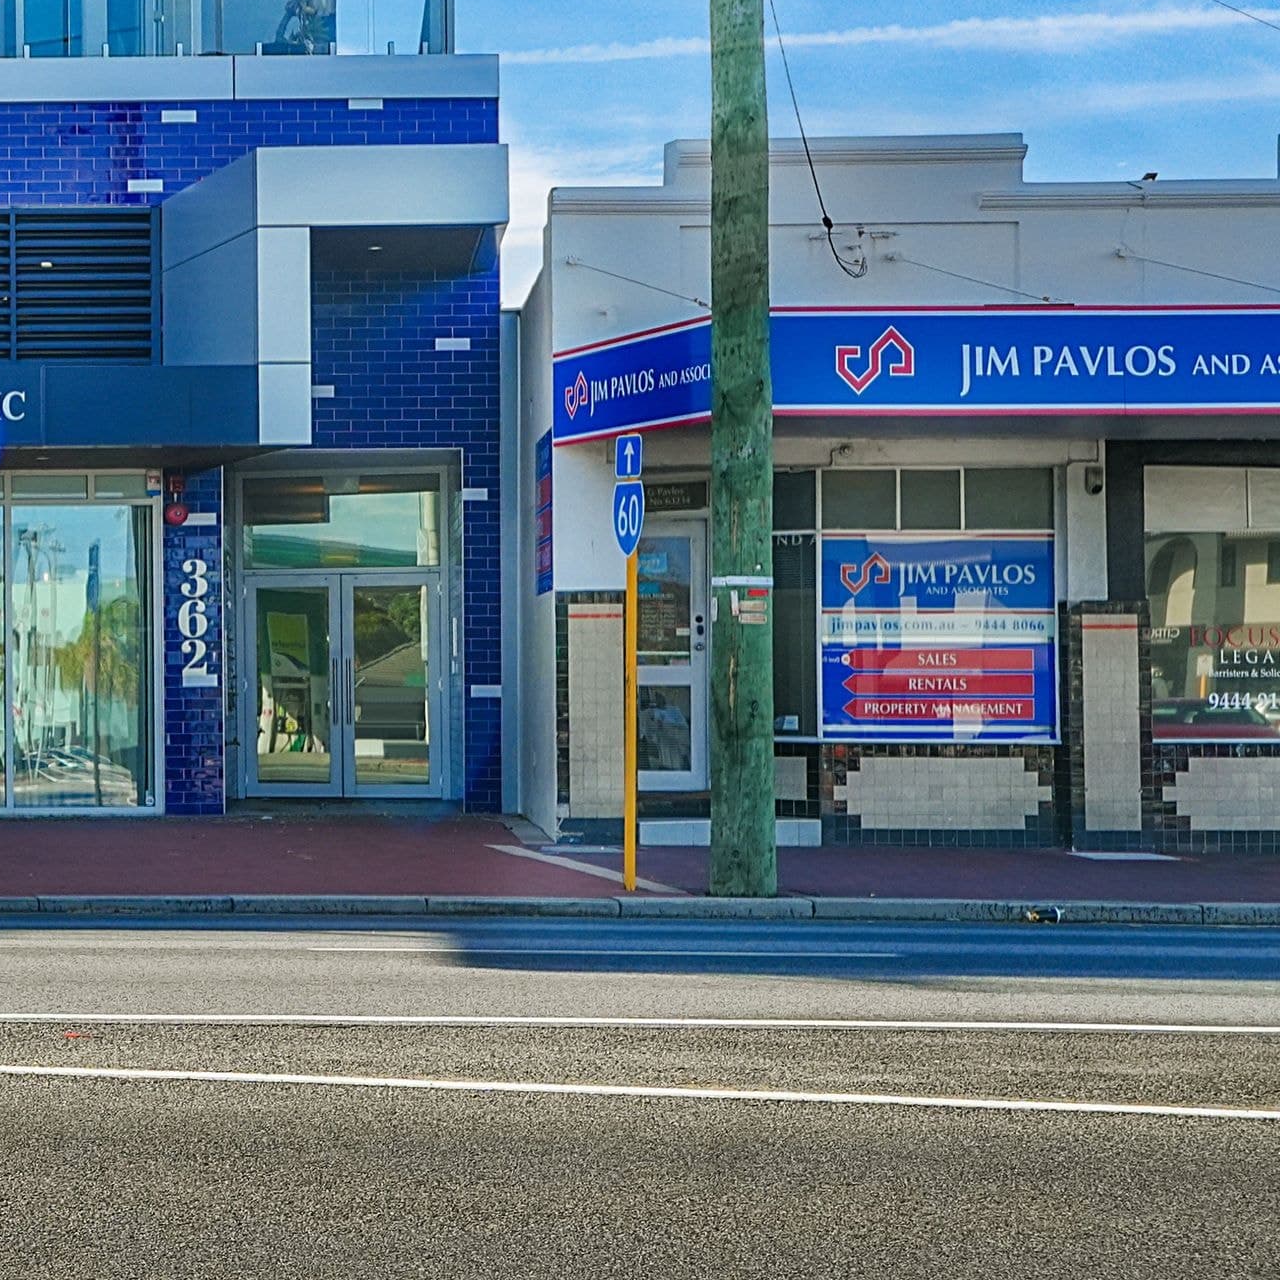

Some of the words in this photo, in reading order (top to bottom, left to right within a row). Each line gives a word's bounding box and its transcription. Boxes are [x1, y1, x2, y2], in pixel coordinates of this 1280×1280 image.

[960, 344, 1020, 396] JIM
[1034, 345, 1177, 377] PAVLOS
[1192, 354, 1251, 376] AND
[1260, 354, 1280, 376] A
[591, 380, 608, 417] JIM
[611, 369, 655, 399] PAVLOS
[658, 371, 678, 389] AND
[618, 494, 639, 537] 60
[898, 563, 936, 596] JIM
[944, 564, 1036, 584] PAVLOS
[926, 586, 948, 595] AND
[951, 586, 1009, 596] ASSOCIATES
[178, 559, 208, 676] 362
[918, 653, 957, 665] SALES
[1251, 668, 1258, 678] &
[908, 678, 967, 691] RENTALS
[864, 703, 927, 715] PROPERTY
[931, 703, 1023, 715] MANAGEMENT
[1208, 692, 1252, 710] 9444
